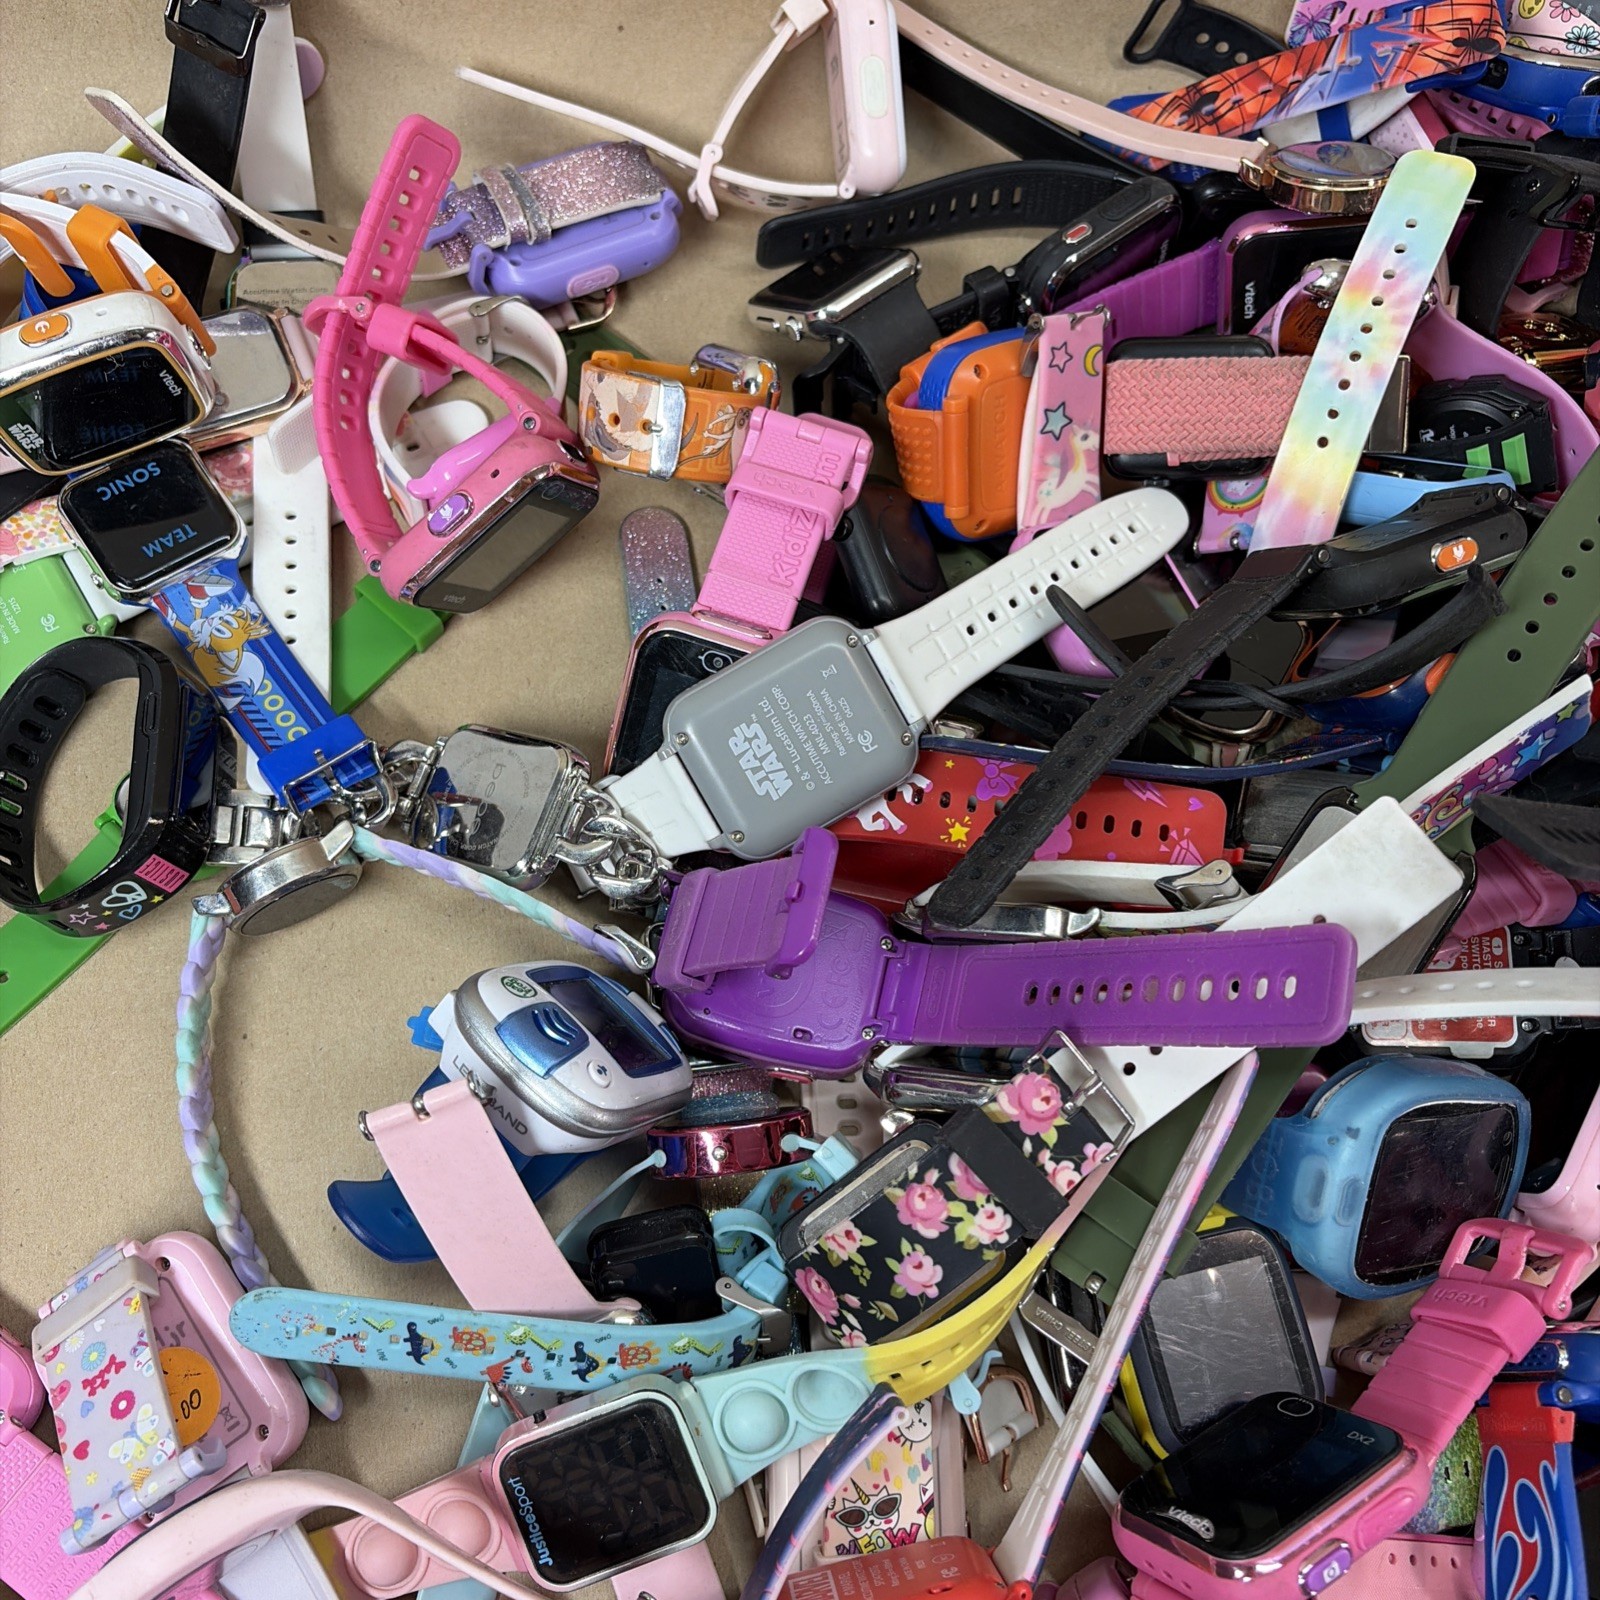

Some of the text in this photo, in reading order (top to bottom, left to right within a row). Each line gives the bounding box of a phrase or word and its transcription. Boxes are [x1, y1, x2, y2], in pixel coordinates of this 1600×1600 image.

[1244, 280, 1256, 319] vtech
[159, 369, 183, 397] vtech
[7, 424, 37, 453] WARS
[17, 422, 45, 447] STAR
[96, 461, 161, 502] SONIC
[141, 523, 198, 558] TEAM
[757, 696, 776, 719] Ltd.
[820, 688, 838, 713] CHINA
[838, 697, 854, 719] 0422S
[771, 684, 834, 786] ACCUTIME WATCH CORP.
[838, 721, 855, 744] MADE
[728, 721, 780, 802] STAR
[748, 721, 794, 798] WARS
[138, 857, 186, 889] JUSTICE
[1470, 936, 1481, 970] SWITC
[1481, 936, 1493, 969] MAST
[452, 1054, 529, 1136] LEBAND
[1433, 1288, 1488, 1308] vtech
[175, 1388, 202, 1423] .00
[1346, 1430, 1375, 1446] DX2
[1168, 1505, 1212, 1535] vtech
[835, 1522, 922, 1557] MEOW
